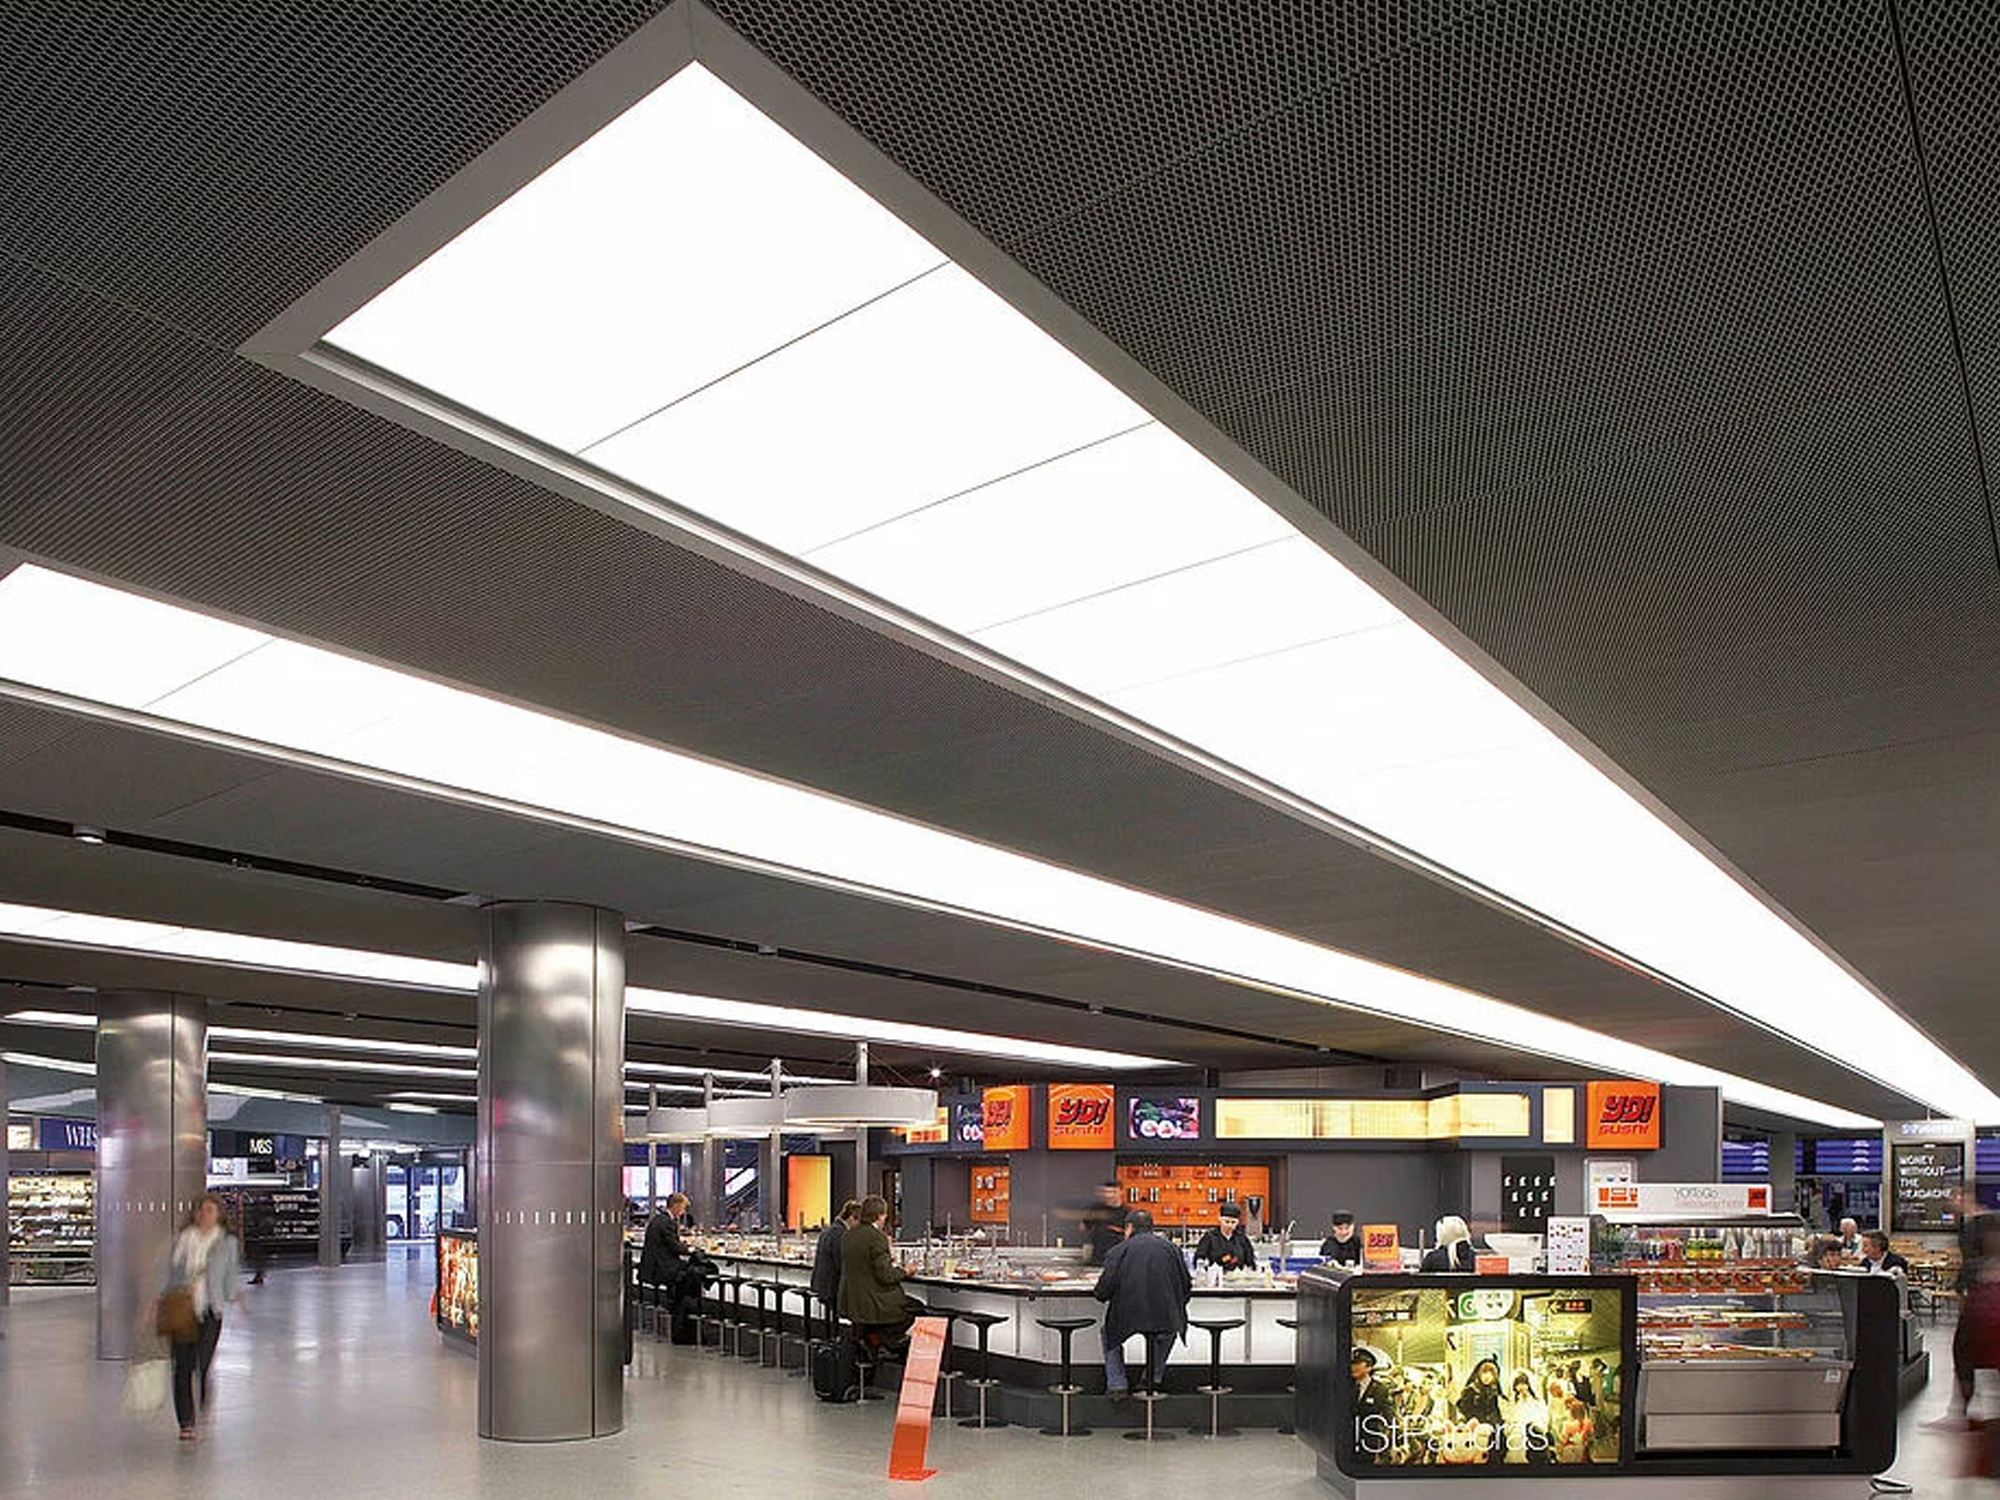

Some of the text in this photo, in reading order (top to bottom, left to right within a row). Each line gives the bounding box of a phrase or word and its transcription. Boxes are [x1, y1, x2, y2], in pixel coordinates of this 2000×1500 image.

[1056, 1098, 1110, 1125] YO!
[1600, 1095, 1656, 1123] YO!
[249, 1139, 273, 1154] M&S
